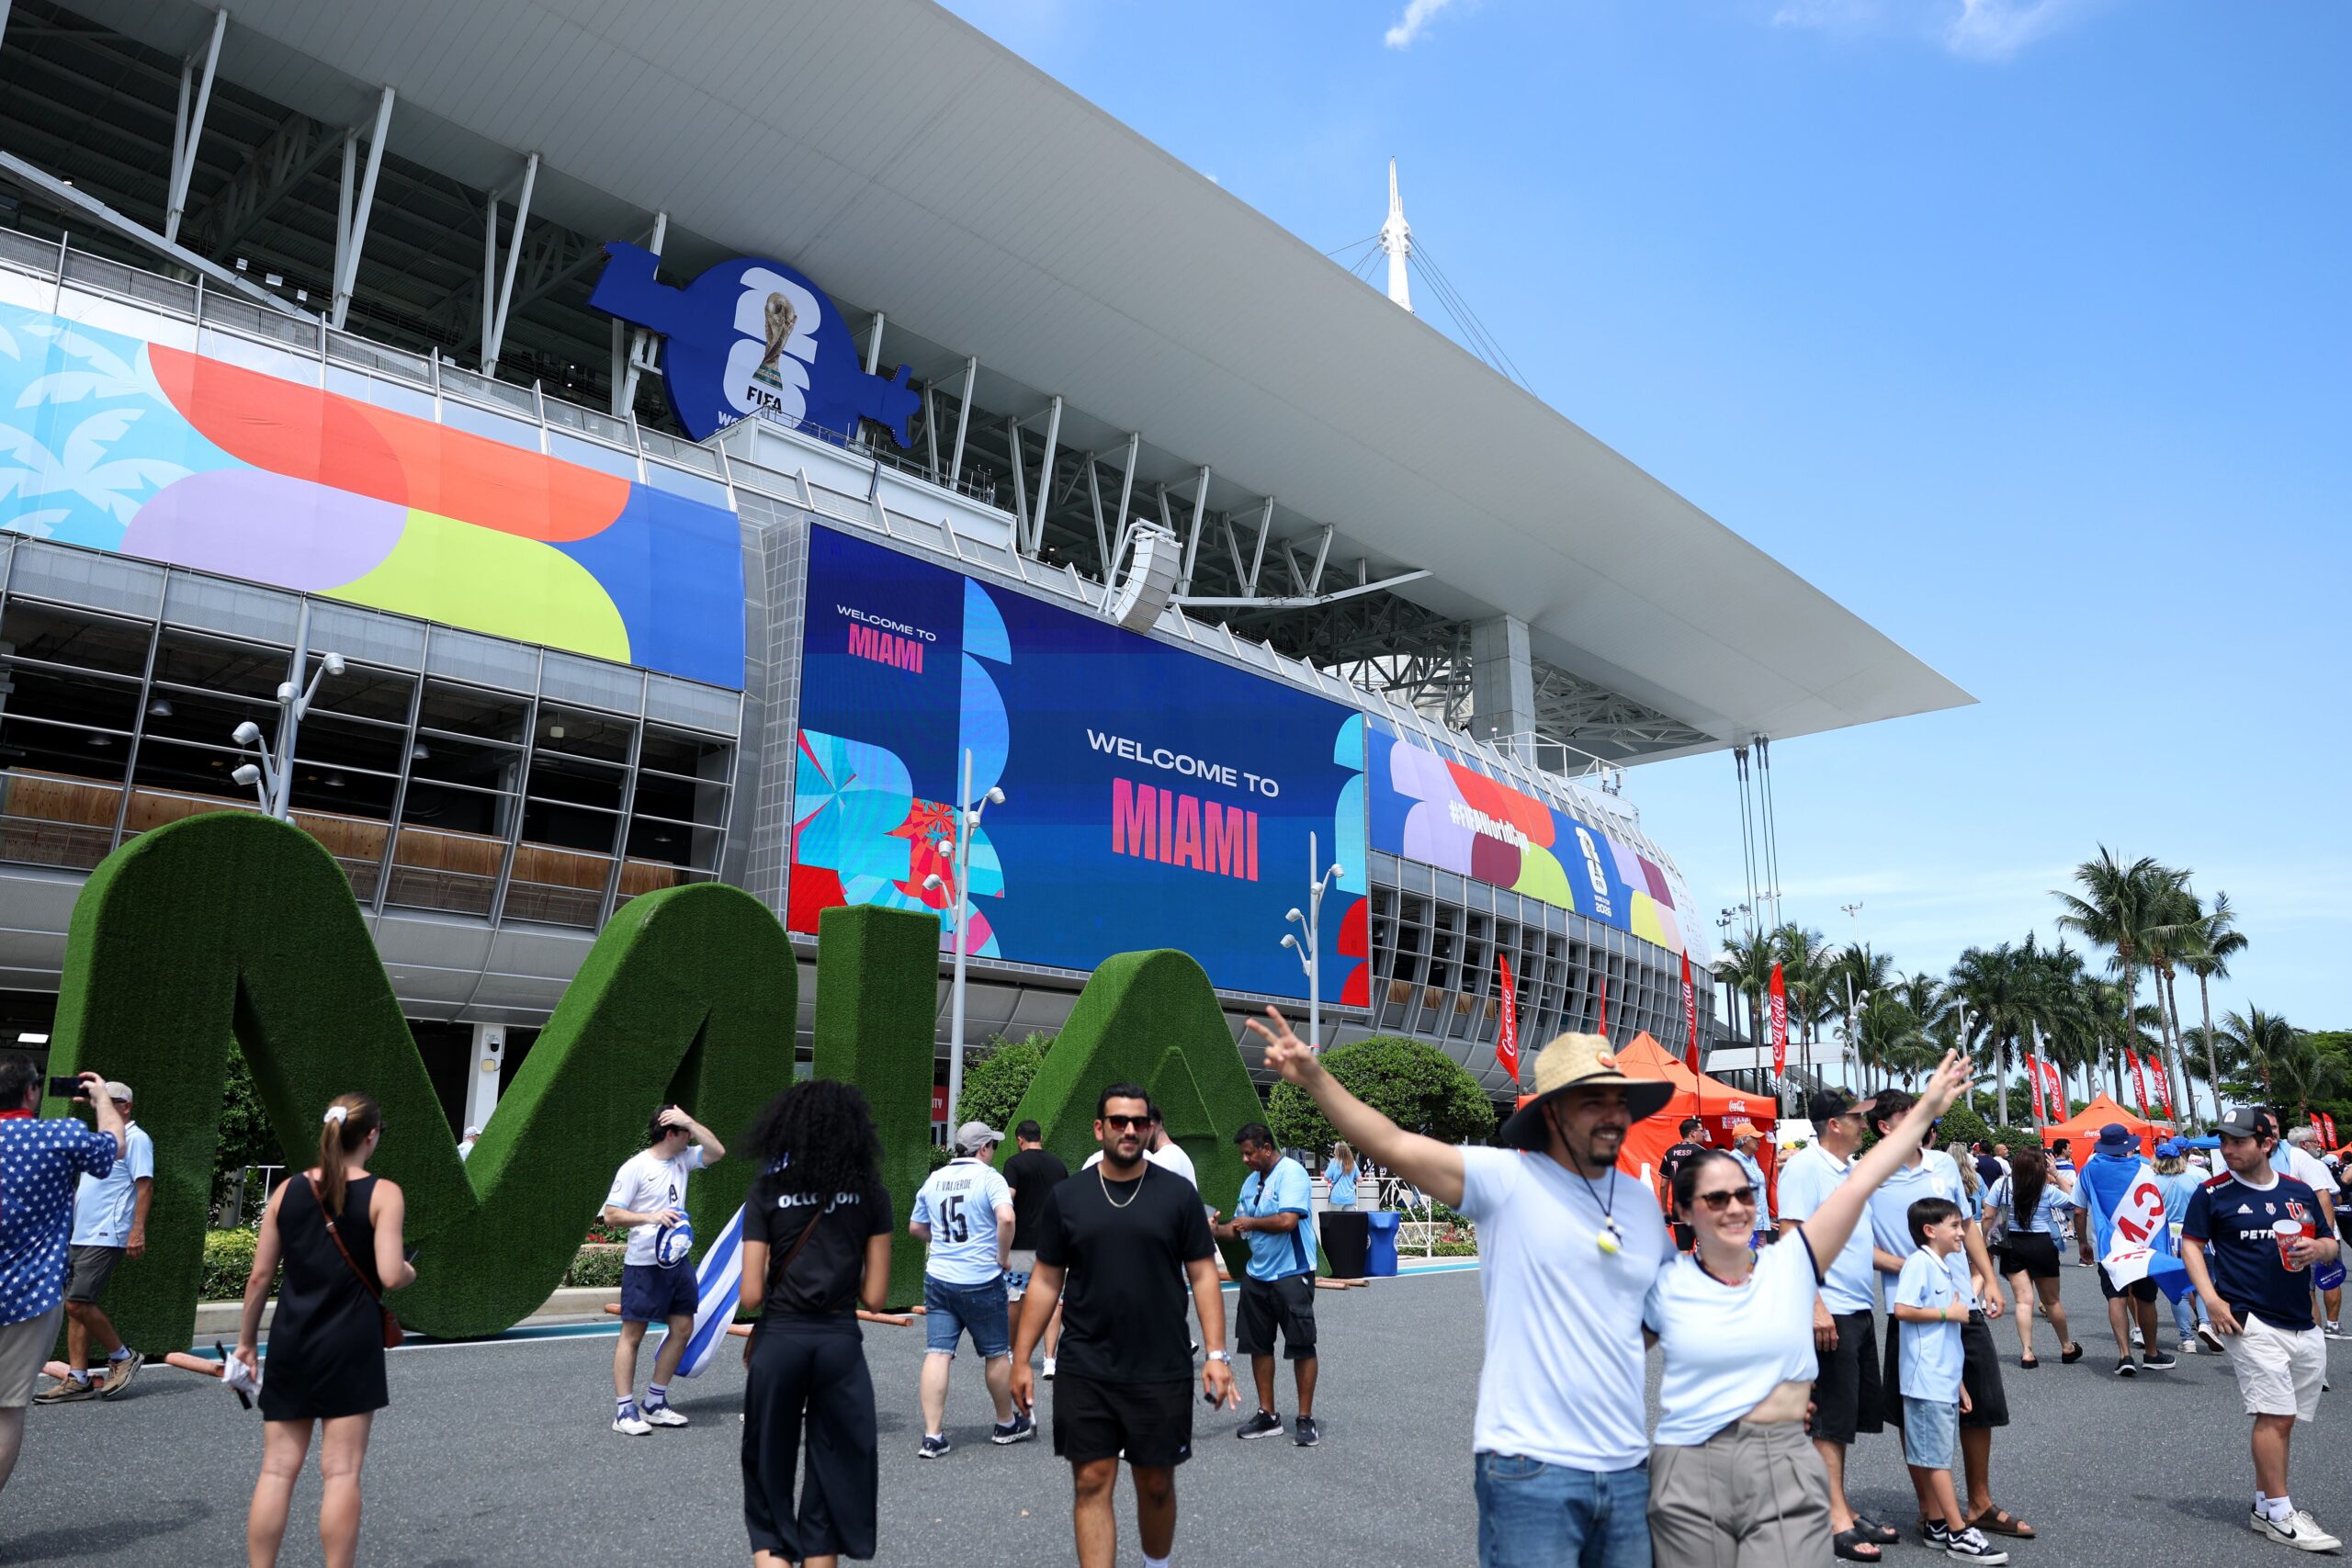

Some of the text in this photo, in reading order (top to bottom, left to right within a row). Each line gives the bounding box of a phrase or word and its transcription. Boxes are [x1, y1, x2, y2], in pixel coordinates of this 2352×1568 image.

[837, 604, 937, 641] WELCOME TO
[848, 623, 923, 674] MIAMI
[1086, 728, 1280, 797] WELCOME TO
[1112, 777, 1259, 882] MIAMI
[939, 1194, 969, 1243] 15
